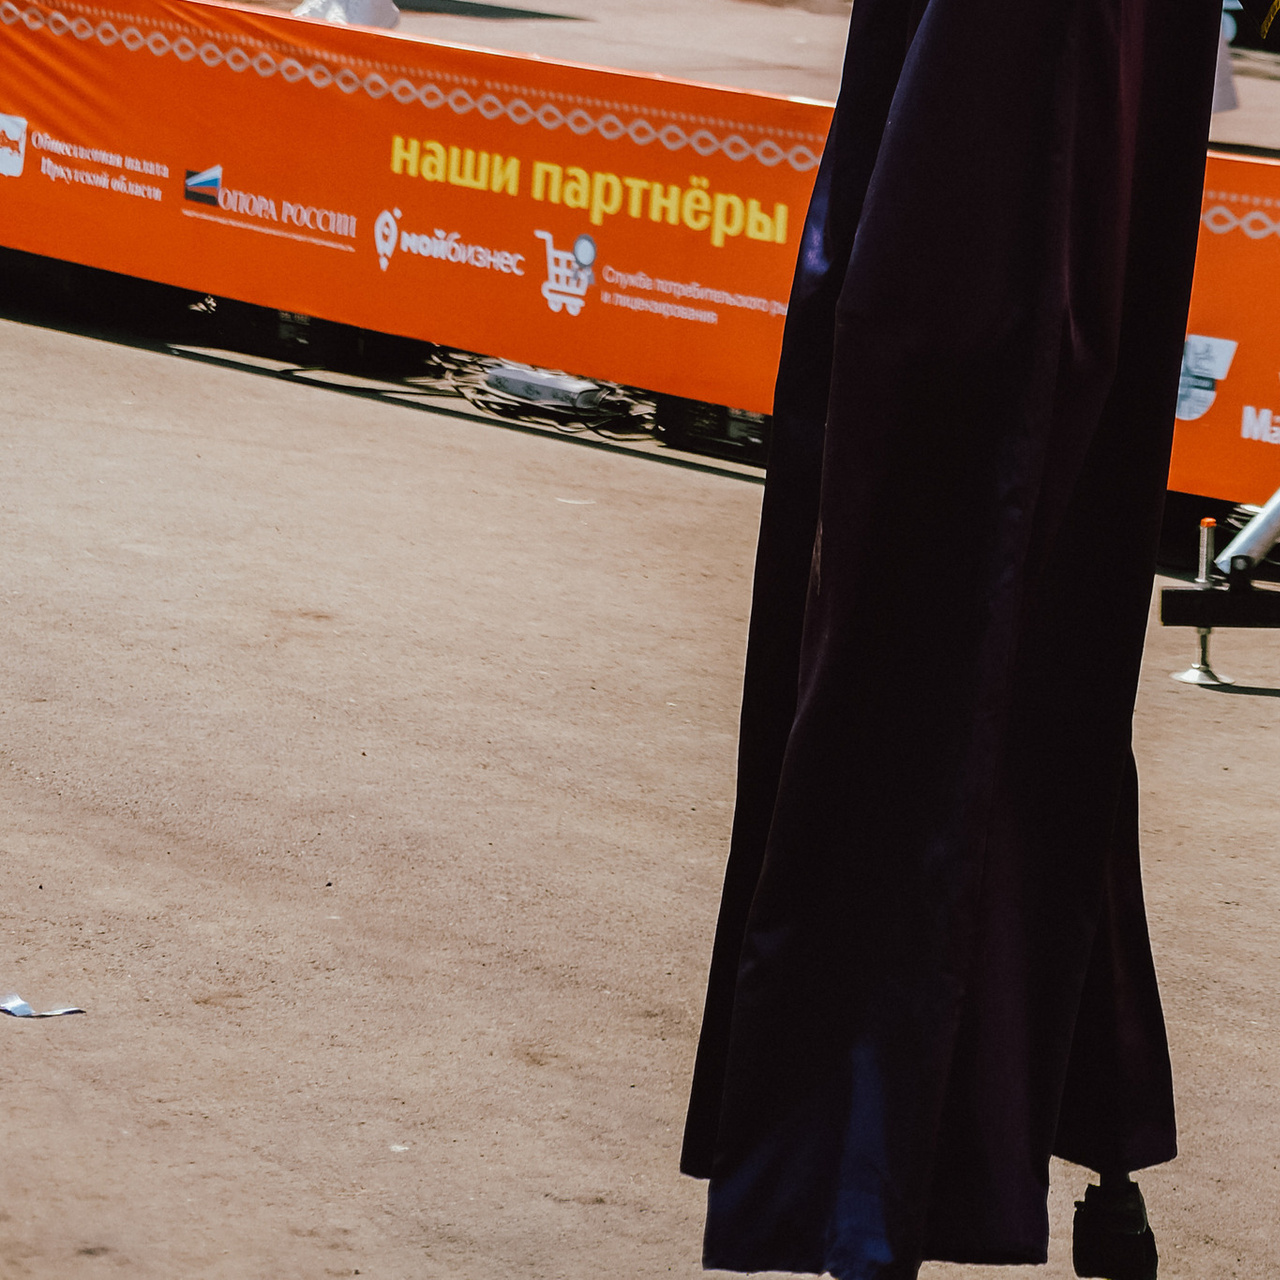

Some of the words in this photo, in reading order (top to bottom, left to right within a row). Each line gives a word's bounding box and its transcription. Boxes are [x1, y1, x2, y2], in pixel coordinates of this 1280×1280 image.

[217, 187, 278, 222] ОПОРА
[390, 134, 521, 197] наши
[531, 160, 789, 249] партнёры
